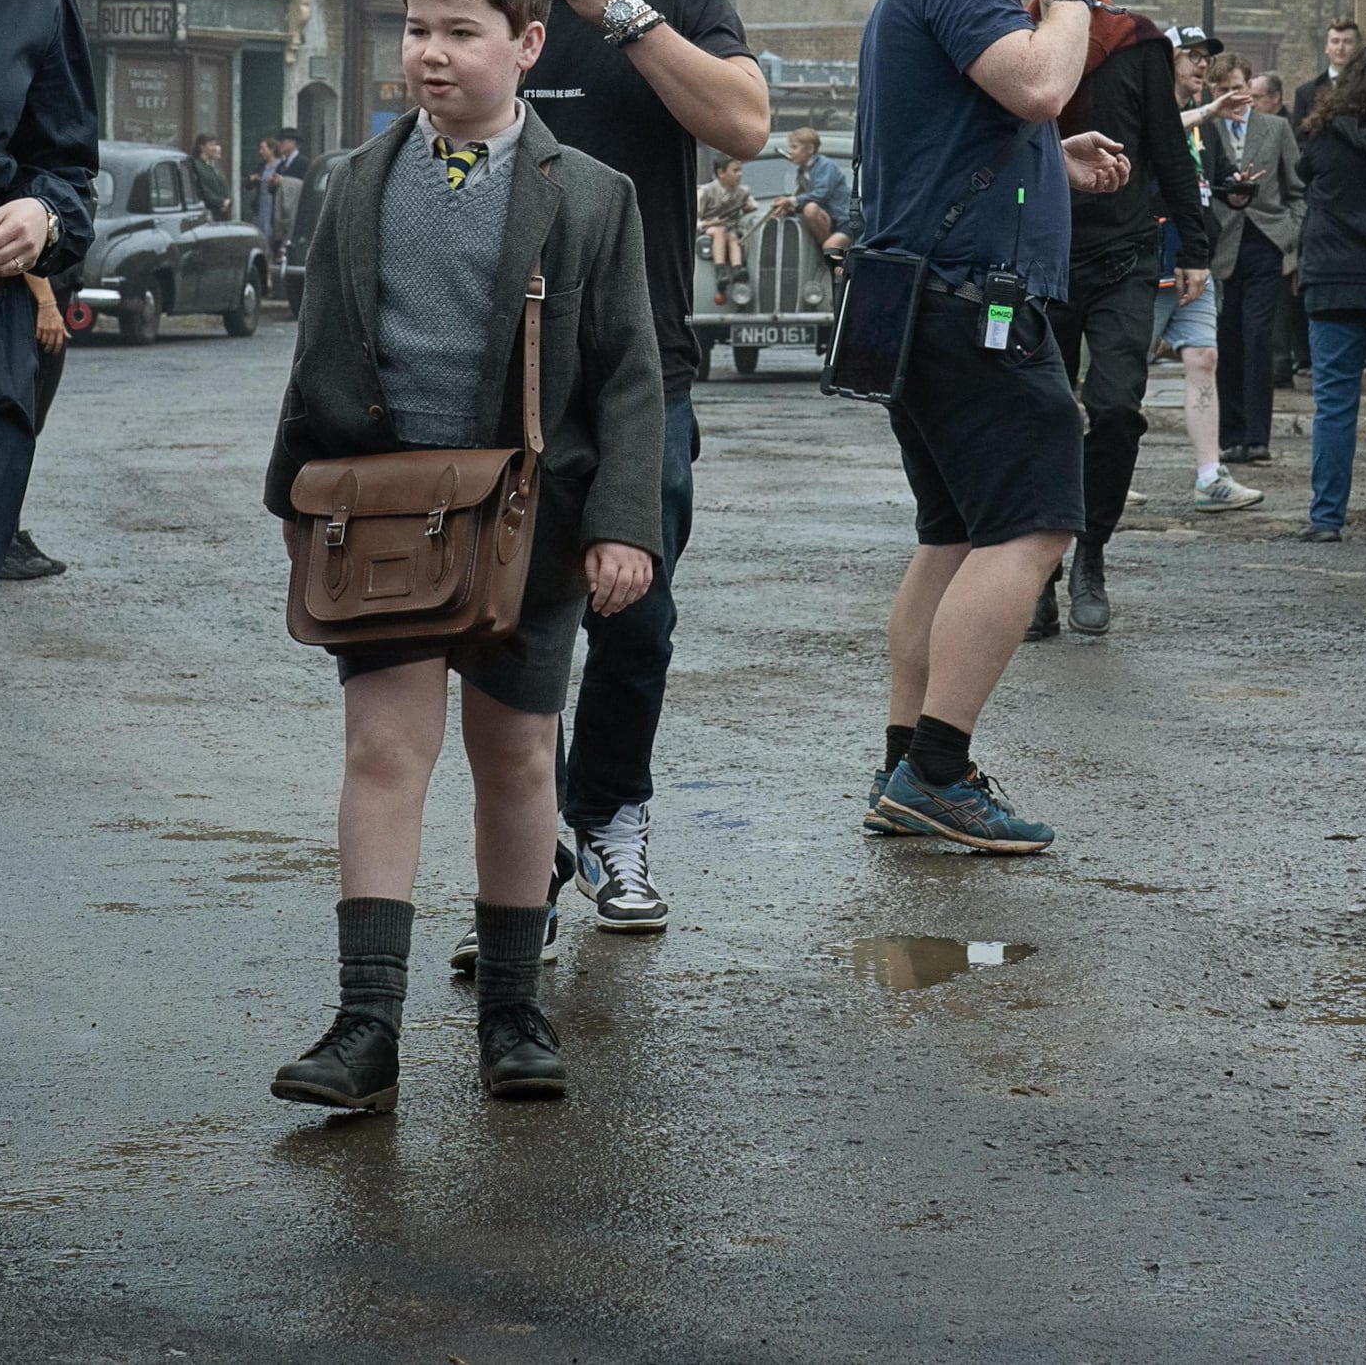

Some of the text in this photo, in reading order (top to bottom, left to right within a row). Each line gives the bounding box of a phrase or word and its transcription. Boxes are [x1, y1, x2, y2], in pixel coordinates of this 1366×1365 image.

[102, 6, 172, 34] BUTCHER
[523, 89, 535, 98] IT'S
[535, 89, 555, 98] GONNA
[556, 89, 564, 98] BE
[741, 327, 806, 343] NHO 161
